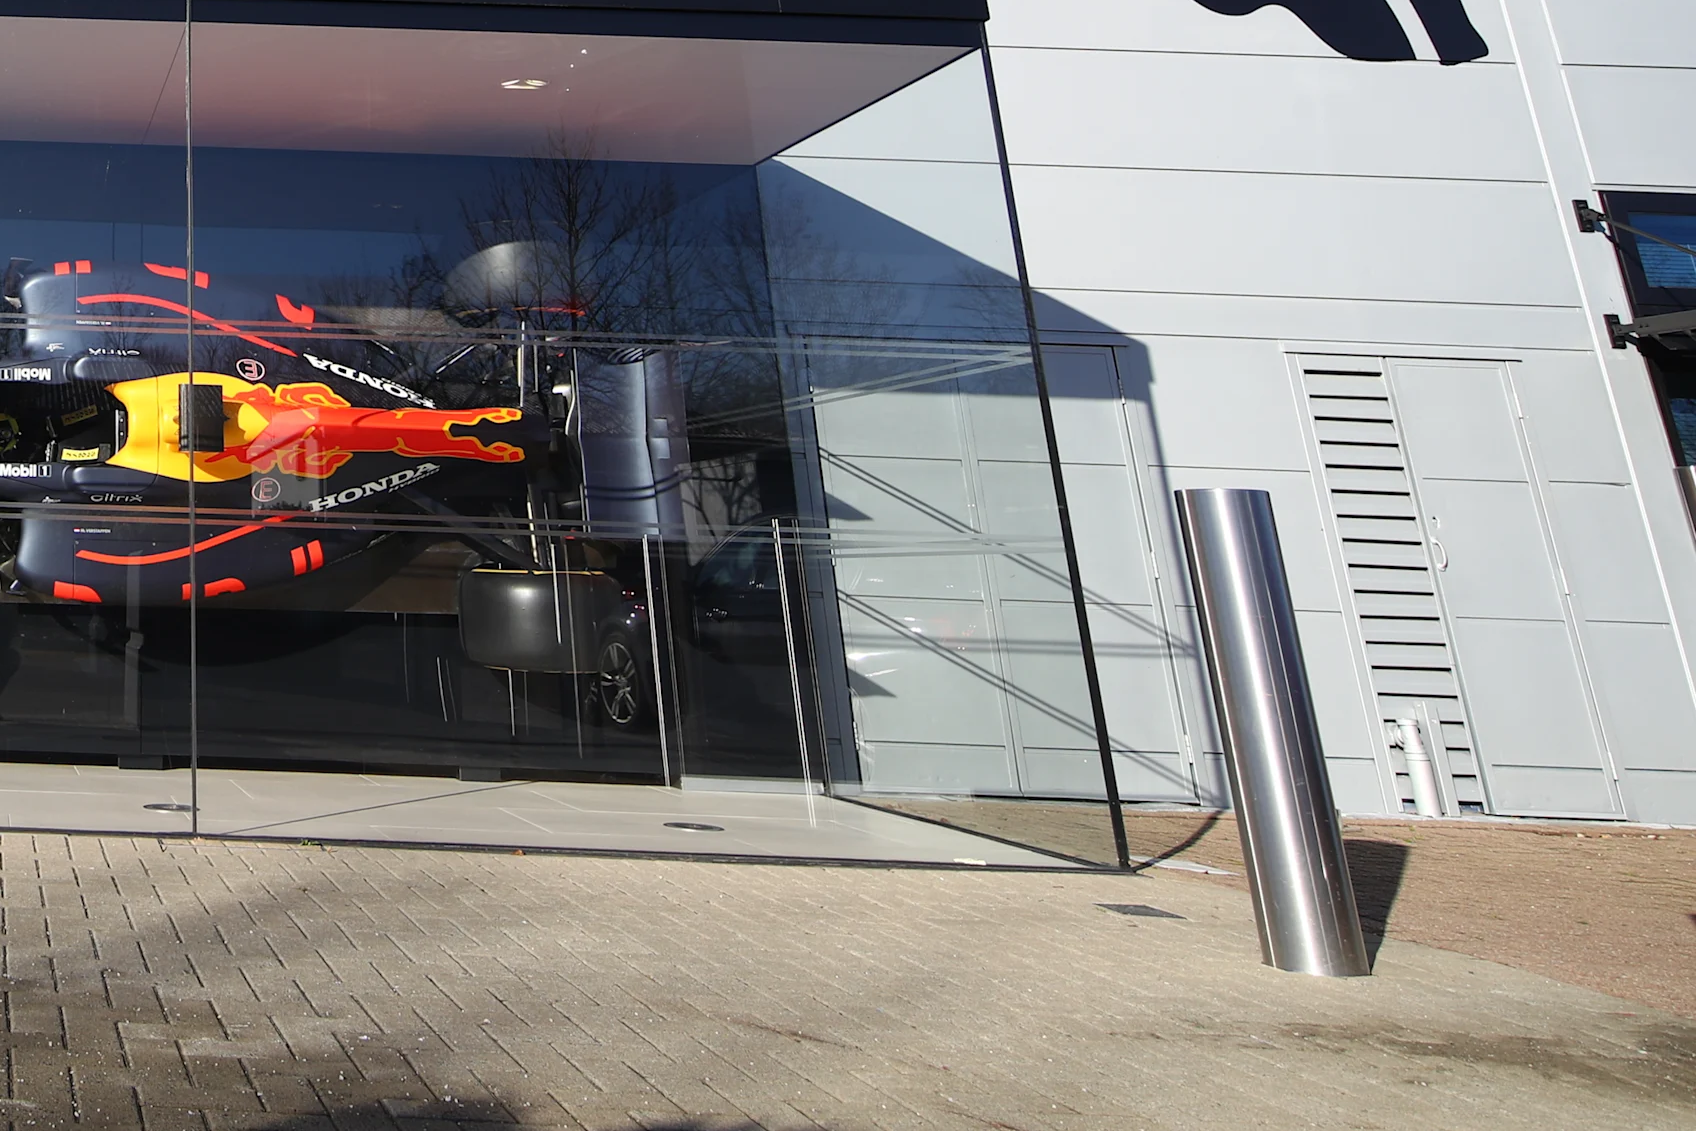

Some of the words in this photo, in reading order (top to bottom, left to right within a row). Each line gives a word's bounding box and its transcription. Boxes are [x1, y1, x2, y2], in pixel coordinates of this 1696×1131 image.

[13, 368, 51, 381] Mobil
[303, 353, 436, 409] HONDA
[0, 464, 37, 477] Mobil
[308, 463, 440, 512] HONDA
